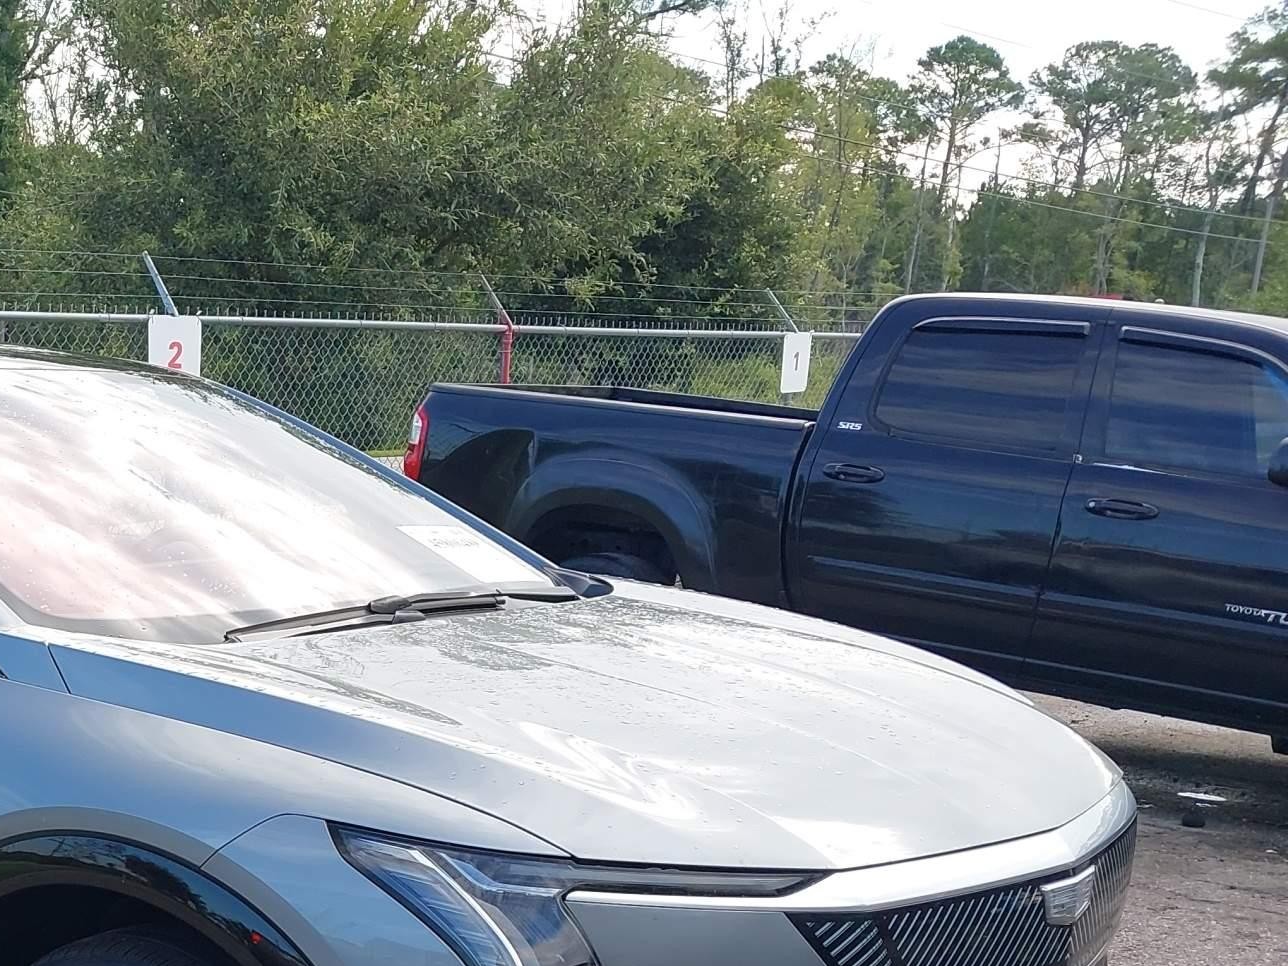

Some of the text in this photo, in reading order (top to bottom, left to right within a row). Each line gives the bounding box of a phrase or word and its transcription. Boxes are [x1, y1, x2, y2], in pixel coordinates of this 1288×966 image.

[167, 341, 183, 369] 2
[793, 351, 801, 372] 1
[837, 421, 863, 431] SR5
[1225, 603, 1265, 618] TOYOTA
